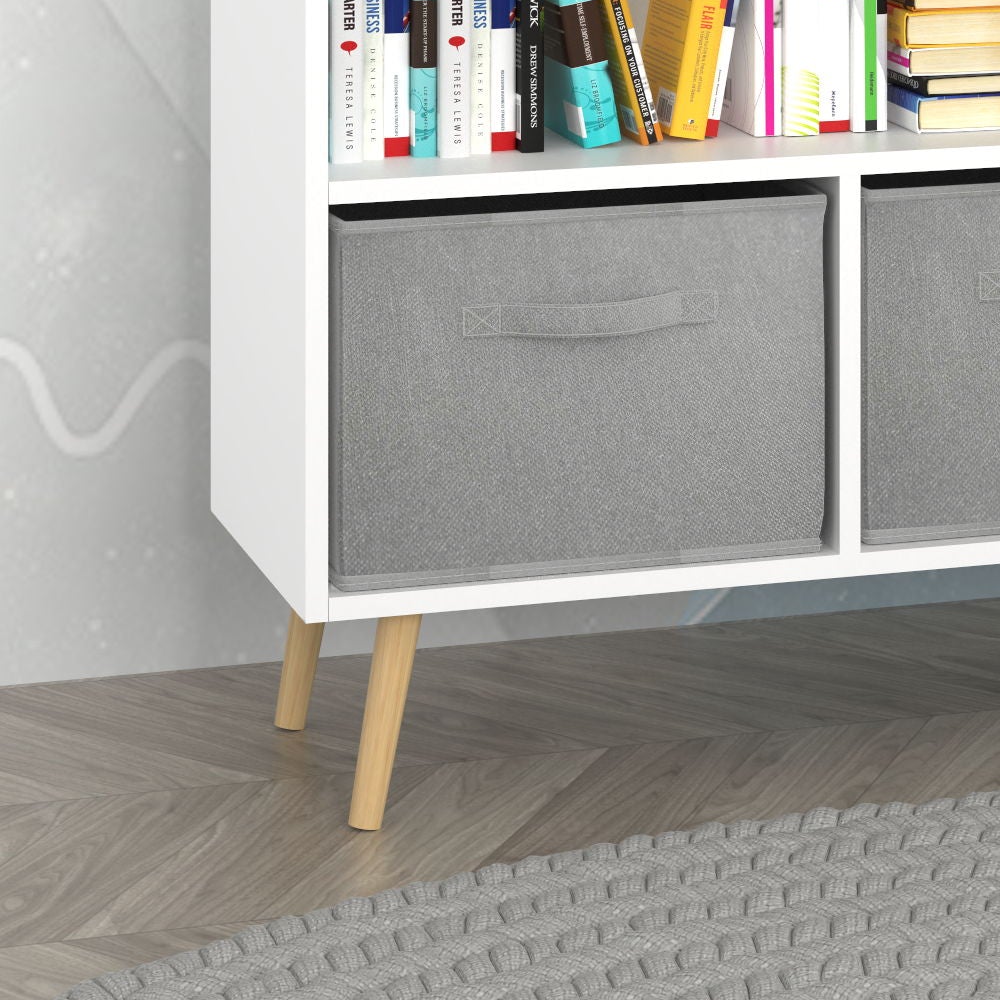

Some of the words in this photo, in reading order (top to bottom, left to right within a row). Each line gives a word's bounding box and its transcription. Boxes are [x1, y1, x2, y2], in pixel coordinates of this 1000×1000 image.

[614, 7, 630, 43] FOCUSING
[699, 5, 716, 29] FLAIR
[530, 45, 538, 77] DREW
[624, 46, 634, 55] ON
[626, 56, 639, 77] YOUR
[345, 67, 353, 109] TERESA
[453, 62, 461, 103] TERESA
[590, 79, 598, 89] LIZ
[632, 78, 649, 117] CUSTOMER
[530, 77, 538, 128] SIMMONS
[592, 90, 604, 128] BROOMFIELD
[345, 116, 353, 150] LEWIS
[453, 110, 461, 144] LEWIS
